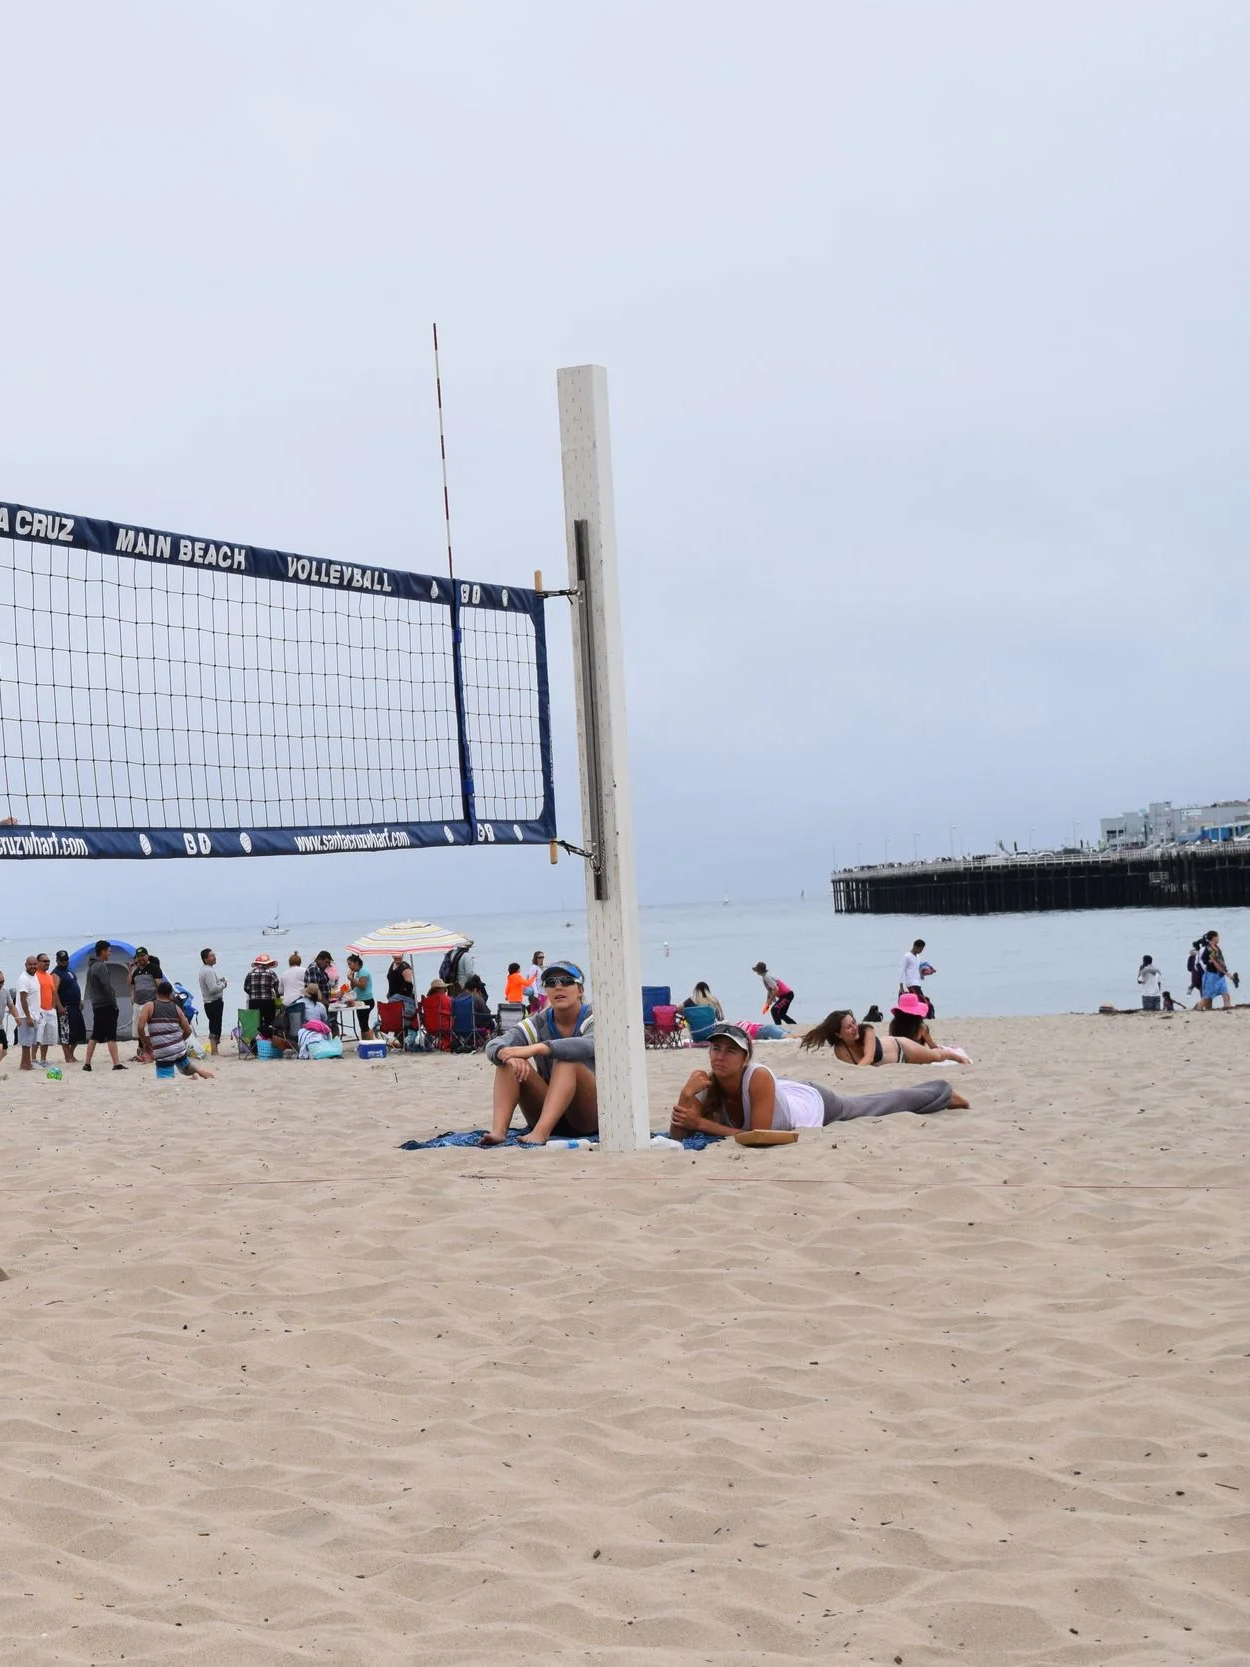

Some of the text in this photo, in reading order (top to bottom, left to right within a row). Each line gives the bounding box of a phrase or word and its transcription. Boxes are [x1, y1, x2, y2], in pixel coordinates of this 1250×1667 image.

[15, 510, 75, 542] CRUZ
[115, 528, 172, 559] MAIN
[178, 539, 246, 570] BEACH
[287, 556, 393, 593] VOLLEYBALL
[294, 827, 411, 853] www.santacruzwharf.com
